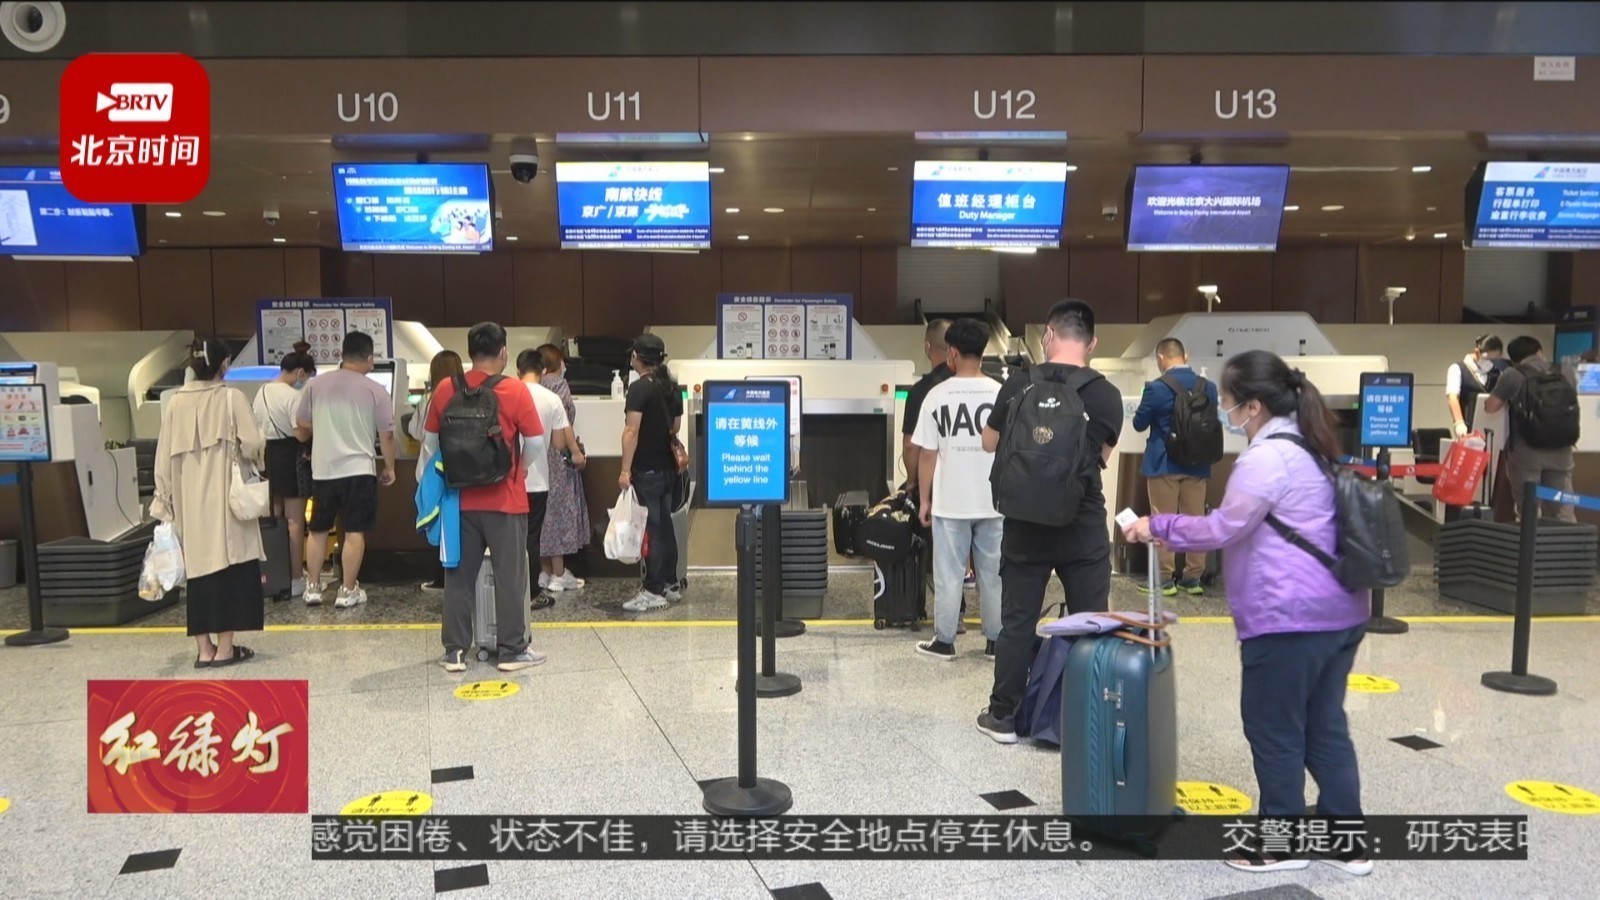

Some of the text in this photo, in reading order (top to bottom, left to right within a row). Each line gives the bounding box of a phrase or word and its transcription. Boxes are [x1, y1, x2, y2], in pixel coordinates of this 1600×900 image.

[337, 92, 399, 122] U10
[587, 91, 641, 121] U11
[974, 89, 1036, 119] U12
[1215, 88, 1277, 119] U13
[604, 186, 663, 202] 南航快线
[937, 193, 1036, 209] 值班经理柜台
[1147, 196, 1261, 207] 欢迎光临北京大兴国际机场
[959, 210, 1016, 220] Duty Manager
[1366, 394, 1405, 404] 请在黄线外
[715, 417, 778, 430] 请在黄线外
[734, 434, 759, 447] 等候
[722, 453, 771, 462] Please wait
[723, 464, 769, 473] behind the
[724, 475, 769, 486] yellow line
